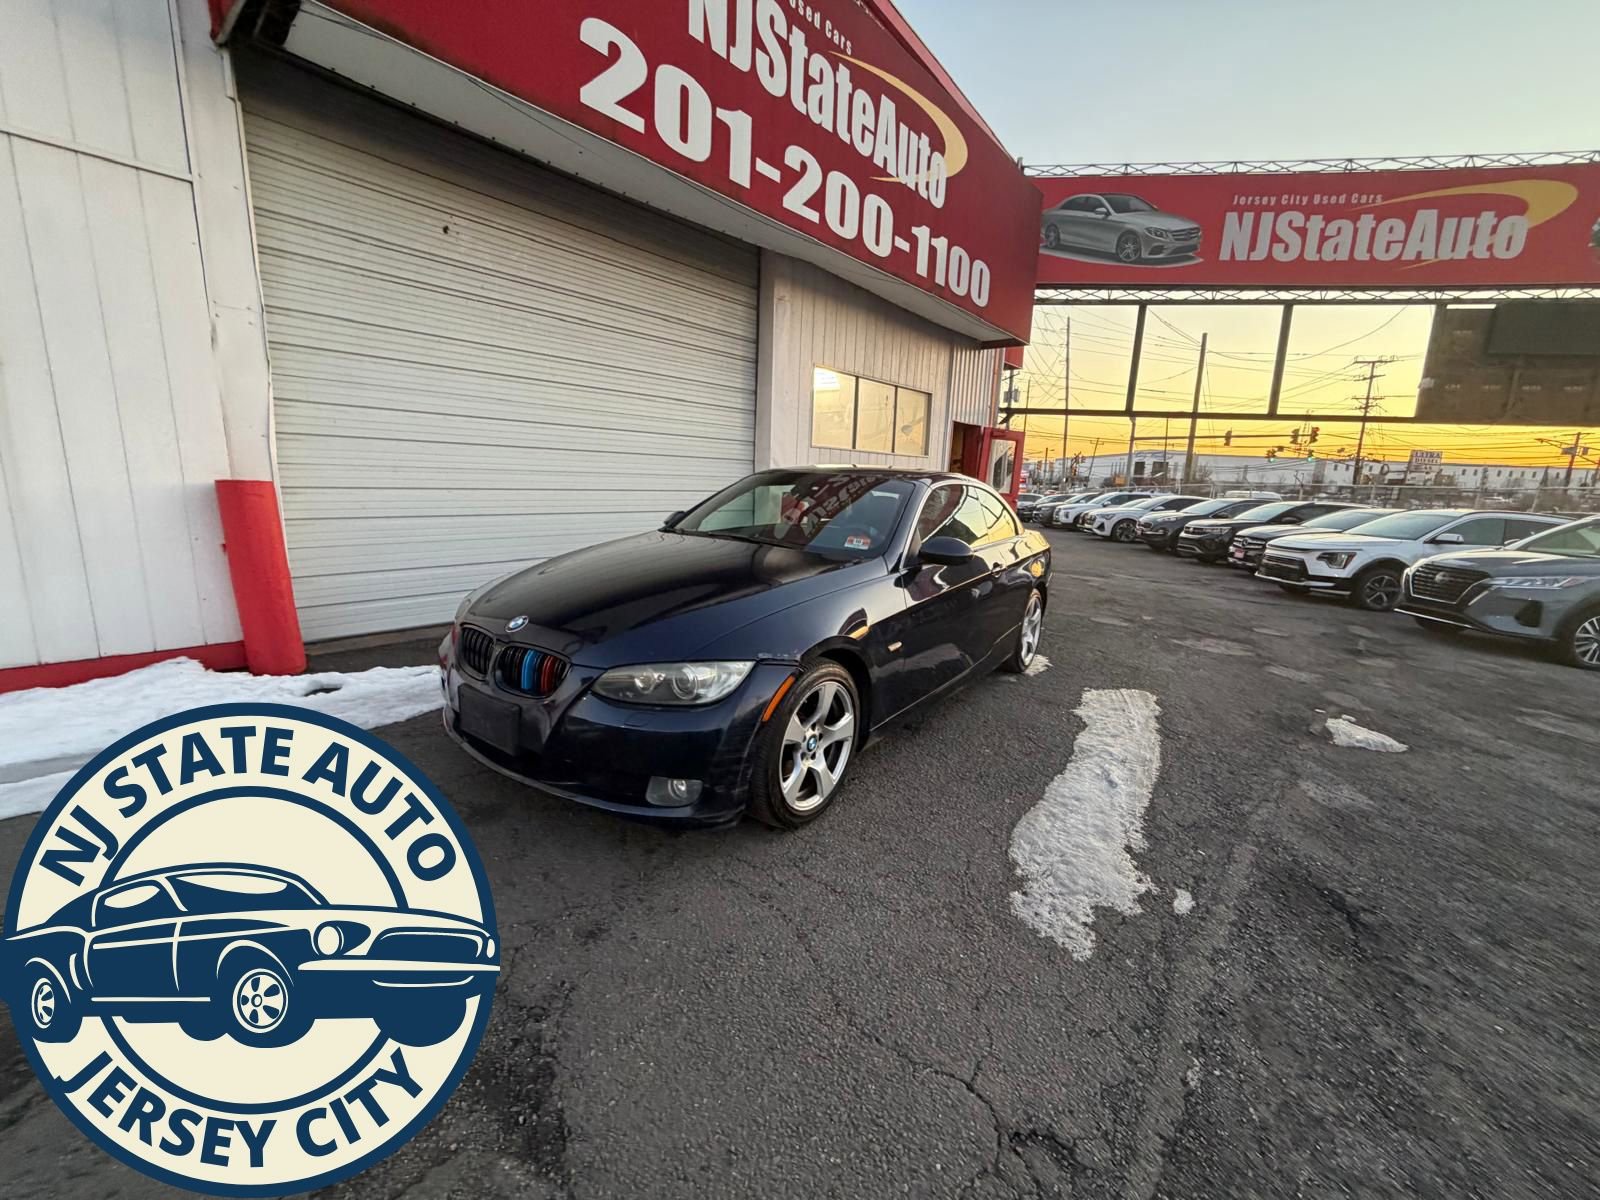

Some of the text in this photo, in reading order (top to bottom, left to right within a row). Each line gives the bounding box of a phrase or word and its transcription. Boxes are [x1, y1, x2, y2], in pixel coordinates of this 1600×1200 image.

[825, 20, 852, 56] Cars
[579, 17, 991, 308] 201-200-1100
[1232, 193, 1383, 206] Jersey City Used Cars
[1218, 209, 1529, 262] NJStateAuto
